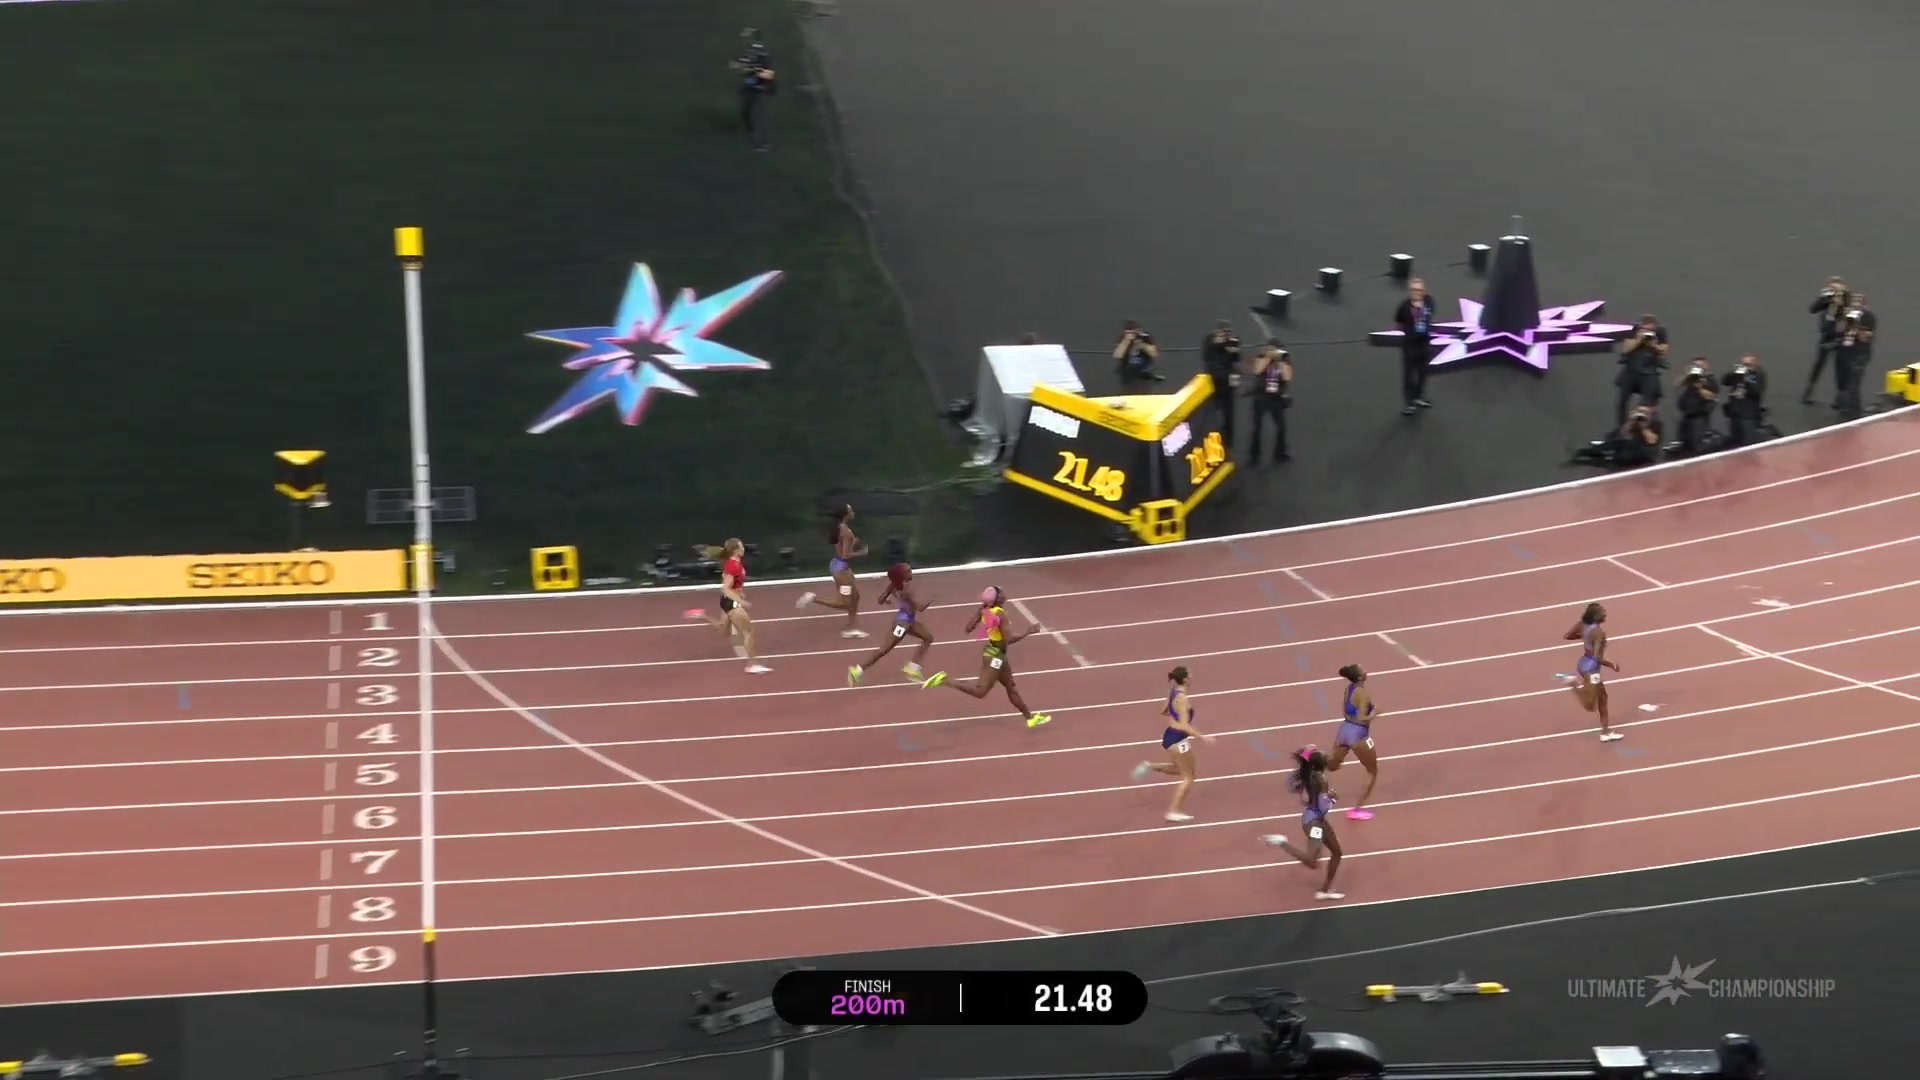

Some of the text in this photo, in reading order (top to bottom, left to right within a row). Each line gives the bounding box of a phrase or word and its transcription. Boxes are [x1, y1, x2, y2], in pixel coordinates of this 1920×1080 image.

[186, 560, 335, 588] SEIKO
[362, 611, 395, 631] 1
[357, 647, 401, 667] 2
[355, 684, 399, 706] 3
[355, 722, 400, 744] 4
[354, 762, 399, 786] 5
[353, 806, 398, 829] 6
[350, 849, 399, 874] 7
[349, 896, 397, 922] 8
[348, 945, 397, 973] 9
